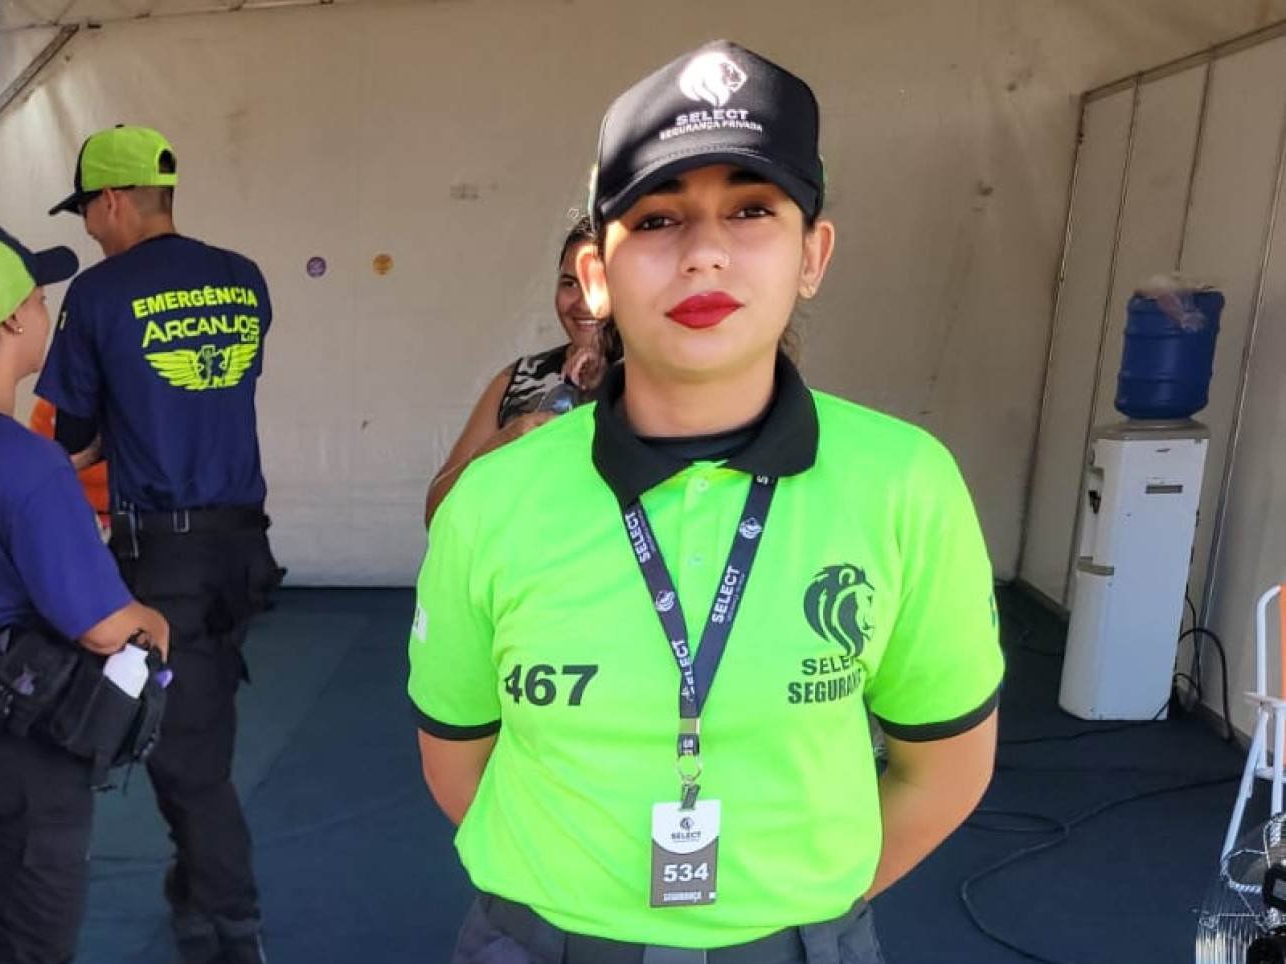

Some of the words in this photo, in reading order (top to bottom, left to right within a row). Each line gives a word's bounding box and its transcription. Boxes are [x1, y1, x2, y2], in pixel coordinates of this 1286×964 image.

[675, 108, 750, 127] SELECT
[131, 284, 259, 319] EMERGÊNCIA
[142, 314, 260, 348] ARCANJOS
[625, 511, 652, 563] SELECT
[711, 566, 740, 624] SELECT
[801, 656, 855, 676] SELE
[504, 663, 599, 707] 467
[663, 863, 709, 882] 534
